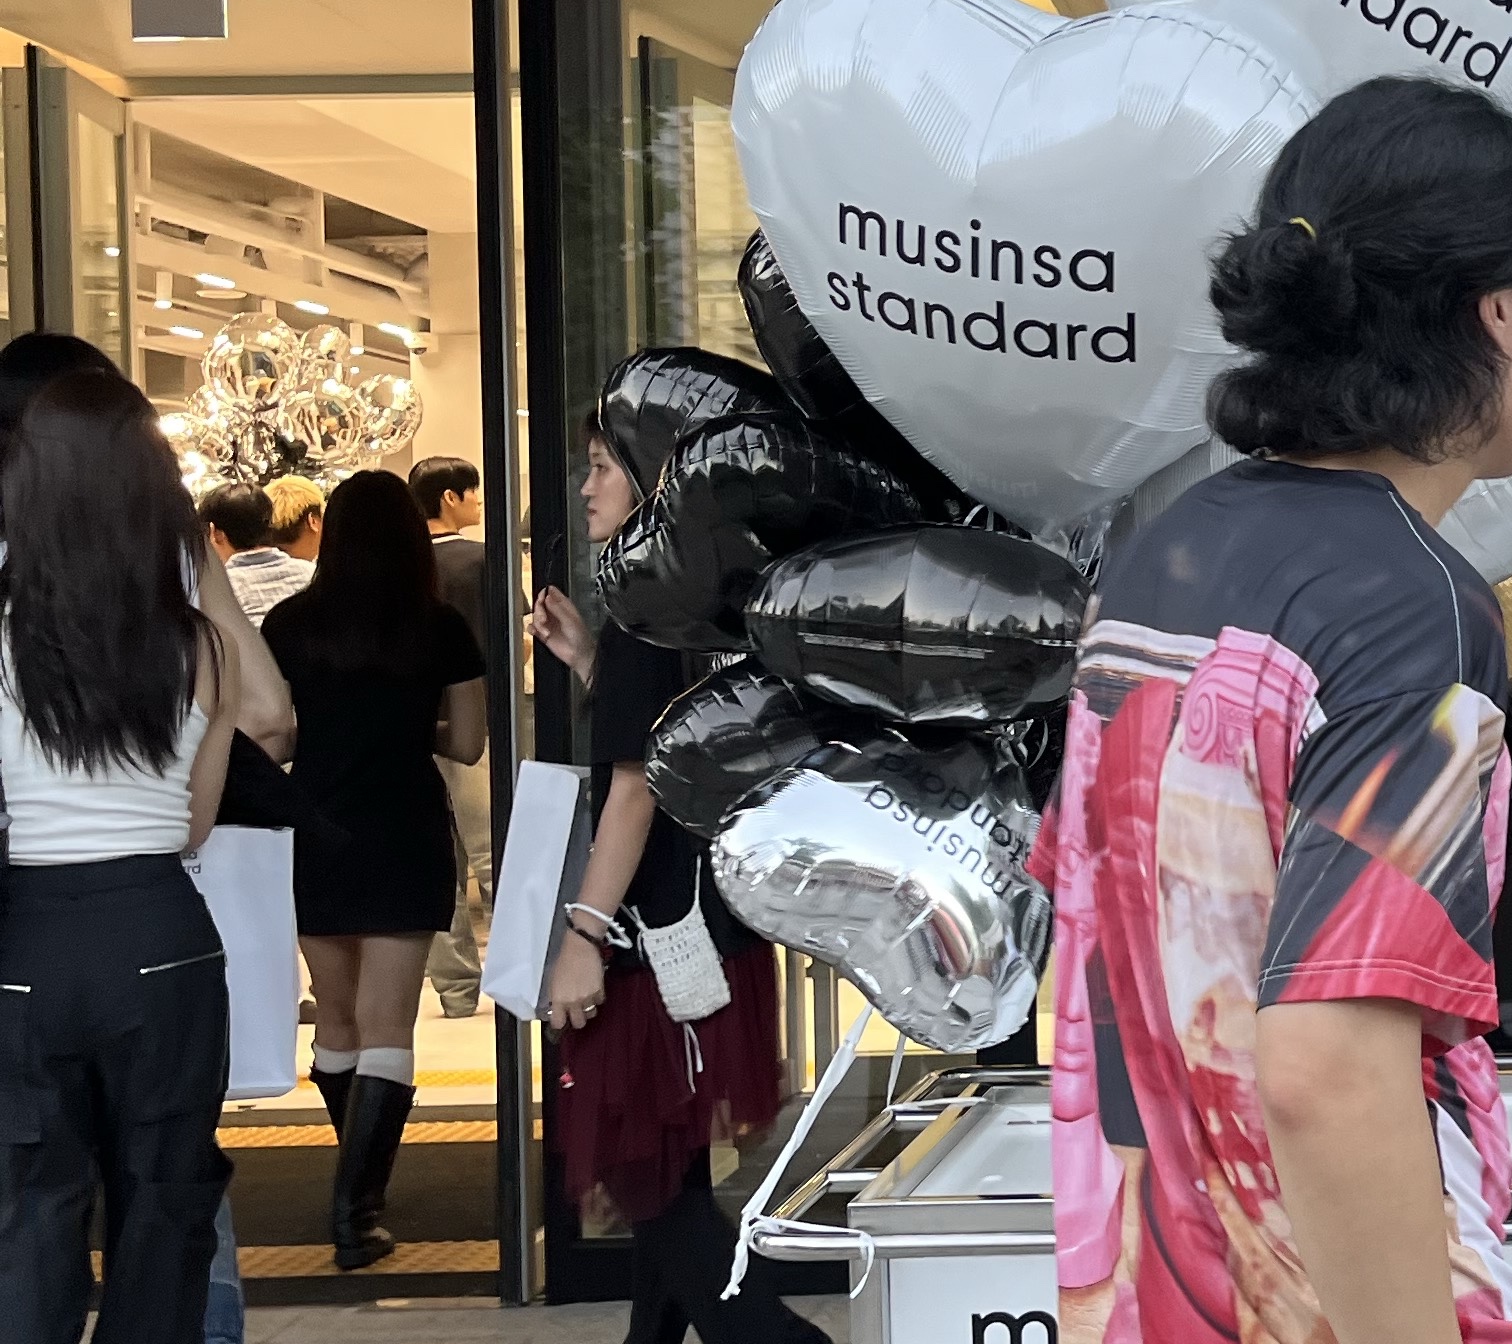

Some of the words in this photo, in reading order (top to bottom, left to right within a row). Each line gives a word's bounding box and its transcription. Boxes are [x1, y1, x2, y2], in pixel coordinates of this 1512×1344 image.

[837, 201, 1116, 294] musinsa
[826, 268, 1138, 364] standard
[862, 783, 1013, 900] musinsa
